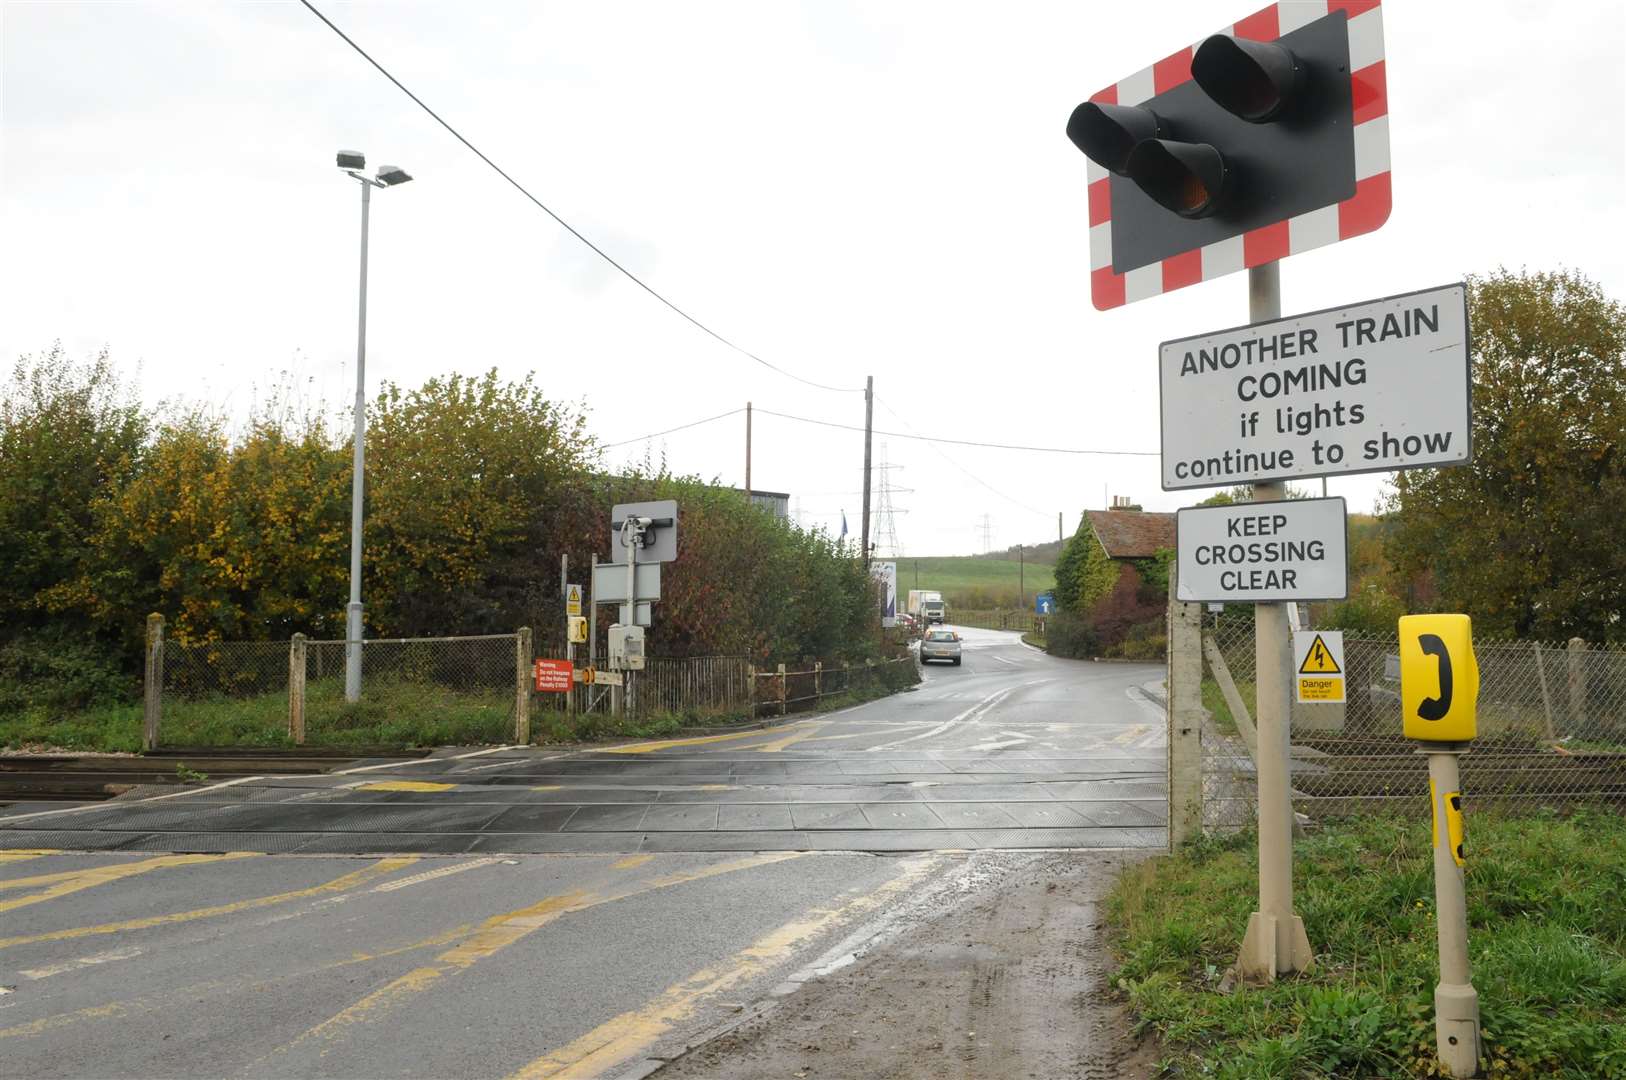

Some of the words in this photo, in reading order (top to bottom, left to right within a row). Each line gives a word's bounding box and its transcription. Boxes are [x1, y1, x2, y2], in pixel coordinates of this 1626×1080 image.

[1180, 328, 1319, 377] ANOTHER
[1335, 304, 1439, 349] TRAIN
[1237, 358, 1367, 402] COMING
[1240, 411, 1260, 438] if
[1276, 401, 1365, 436] lights
[1175, 448, 1294, 480] continue
[1311, 439, 1344, 466] to
[1363, 431, 1453, 460] show
[1227, 514, 1287, 538] KEEP
[1195, 540, 1325, 566] CROSSING
[1220, 569, 1297, 591] CLEAR
[1302, 680, 1332, 689] Danger
